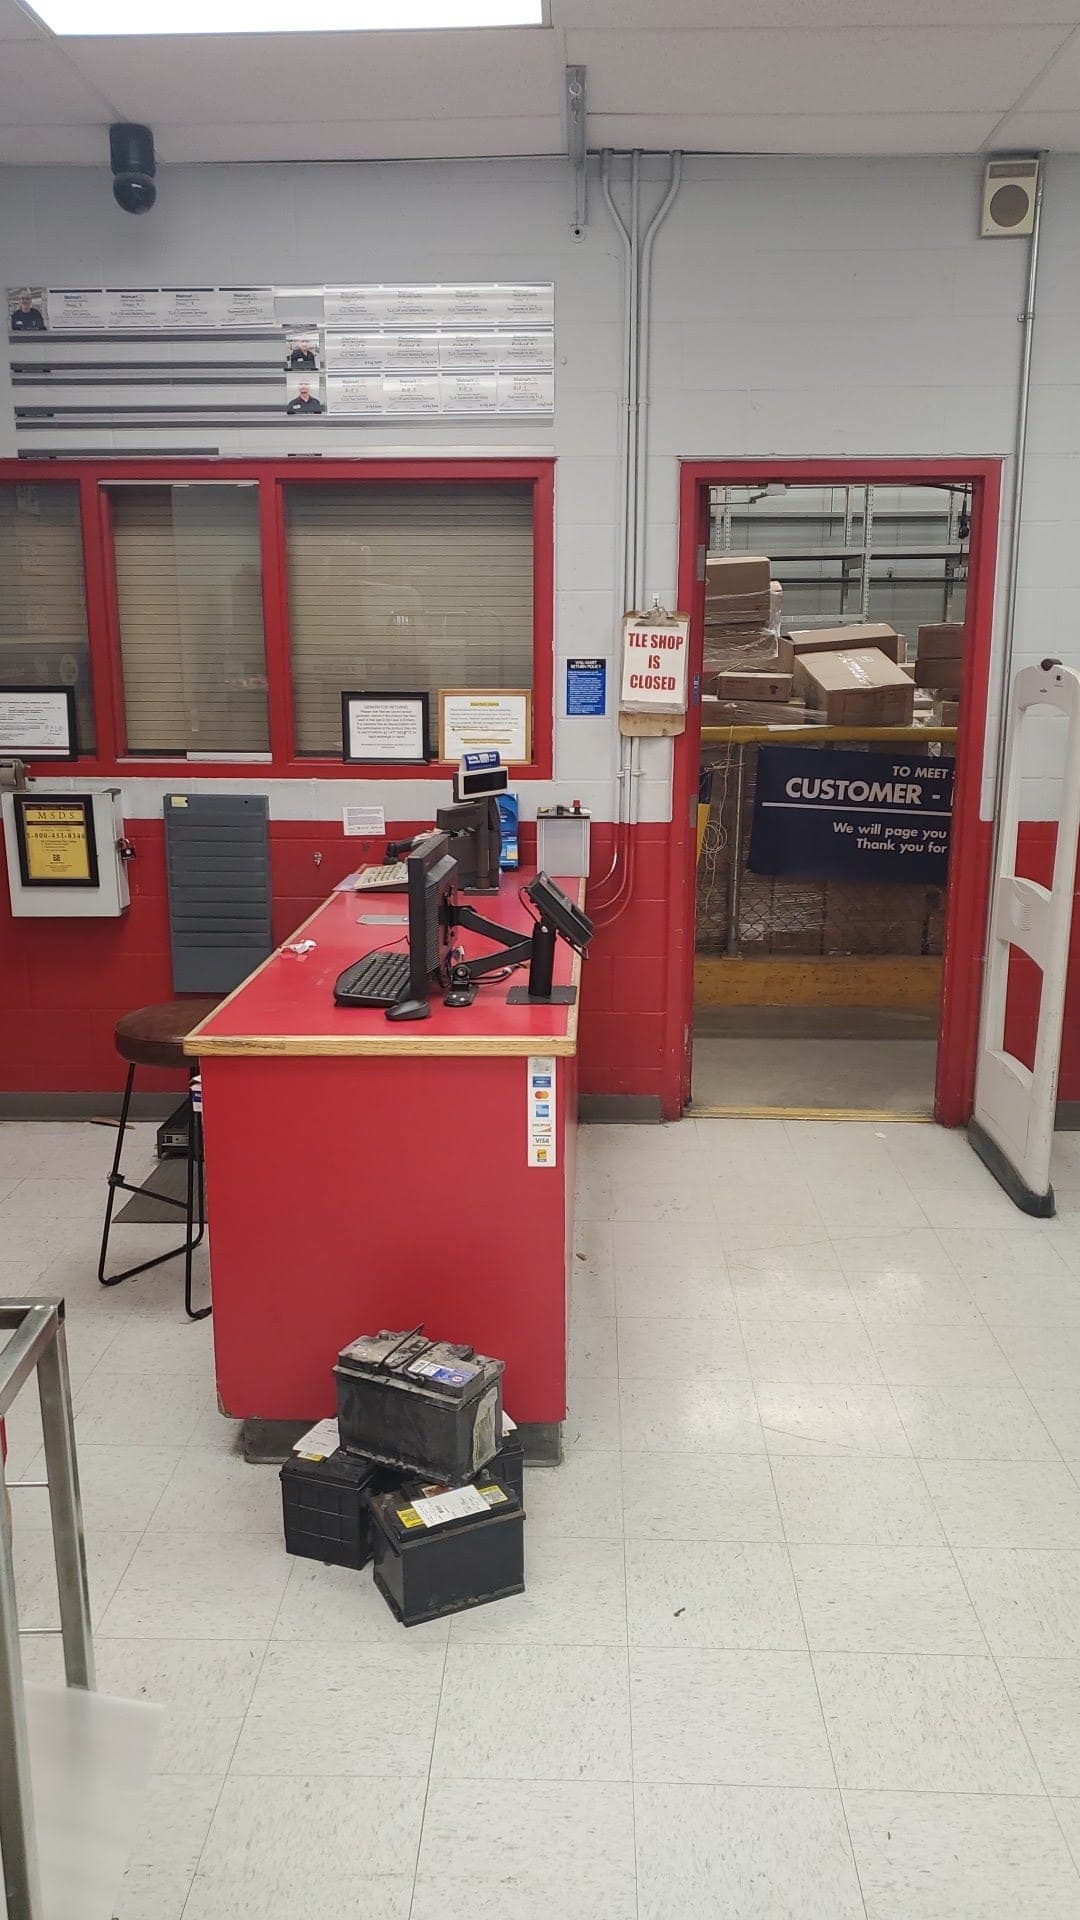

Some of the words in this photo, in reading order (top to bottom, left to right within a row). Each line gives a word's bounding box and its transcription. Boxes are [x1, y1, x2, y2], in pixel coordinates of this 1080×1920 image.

[629, 633, 647, 648] TLE
[651, 635, 683, 650] SHOP
[648, 655, 661, 669] IS
[630, 675, 675, 690] CLOSED
[892, 765, 911, 778] TO
[915, 767, 949, 780] MEET
[786, 777, 922, 804] CUSTOMER
[833, 822, 854, 834] We
[858, 823, 881, 835] will
[885, 826, 919, 840] page
[922, 829, 947, 841] you
[856, 838, 895, 851] Thank
[900, 842, 924, 854] you
[928, 842, 948, 854] for
